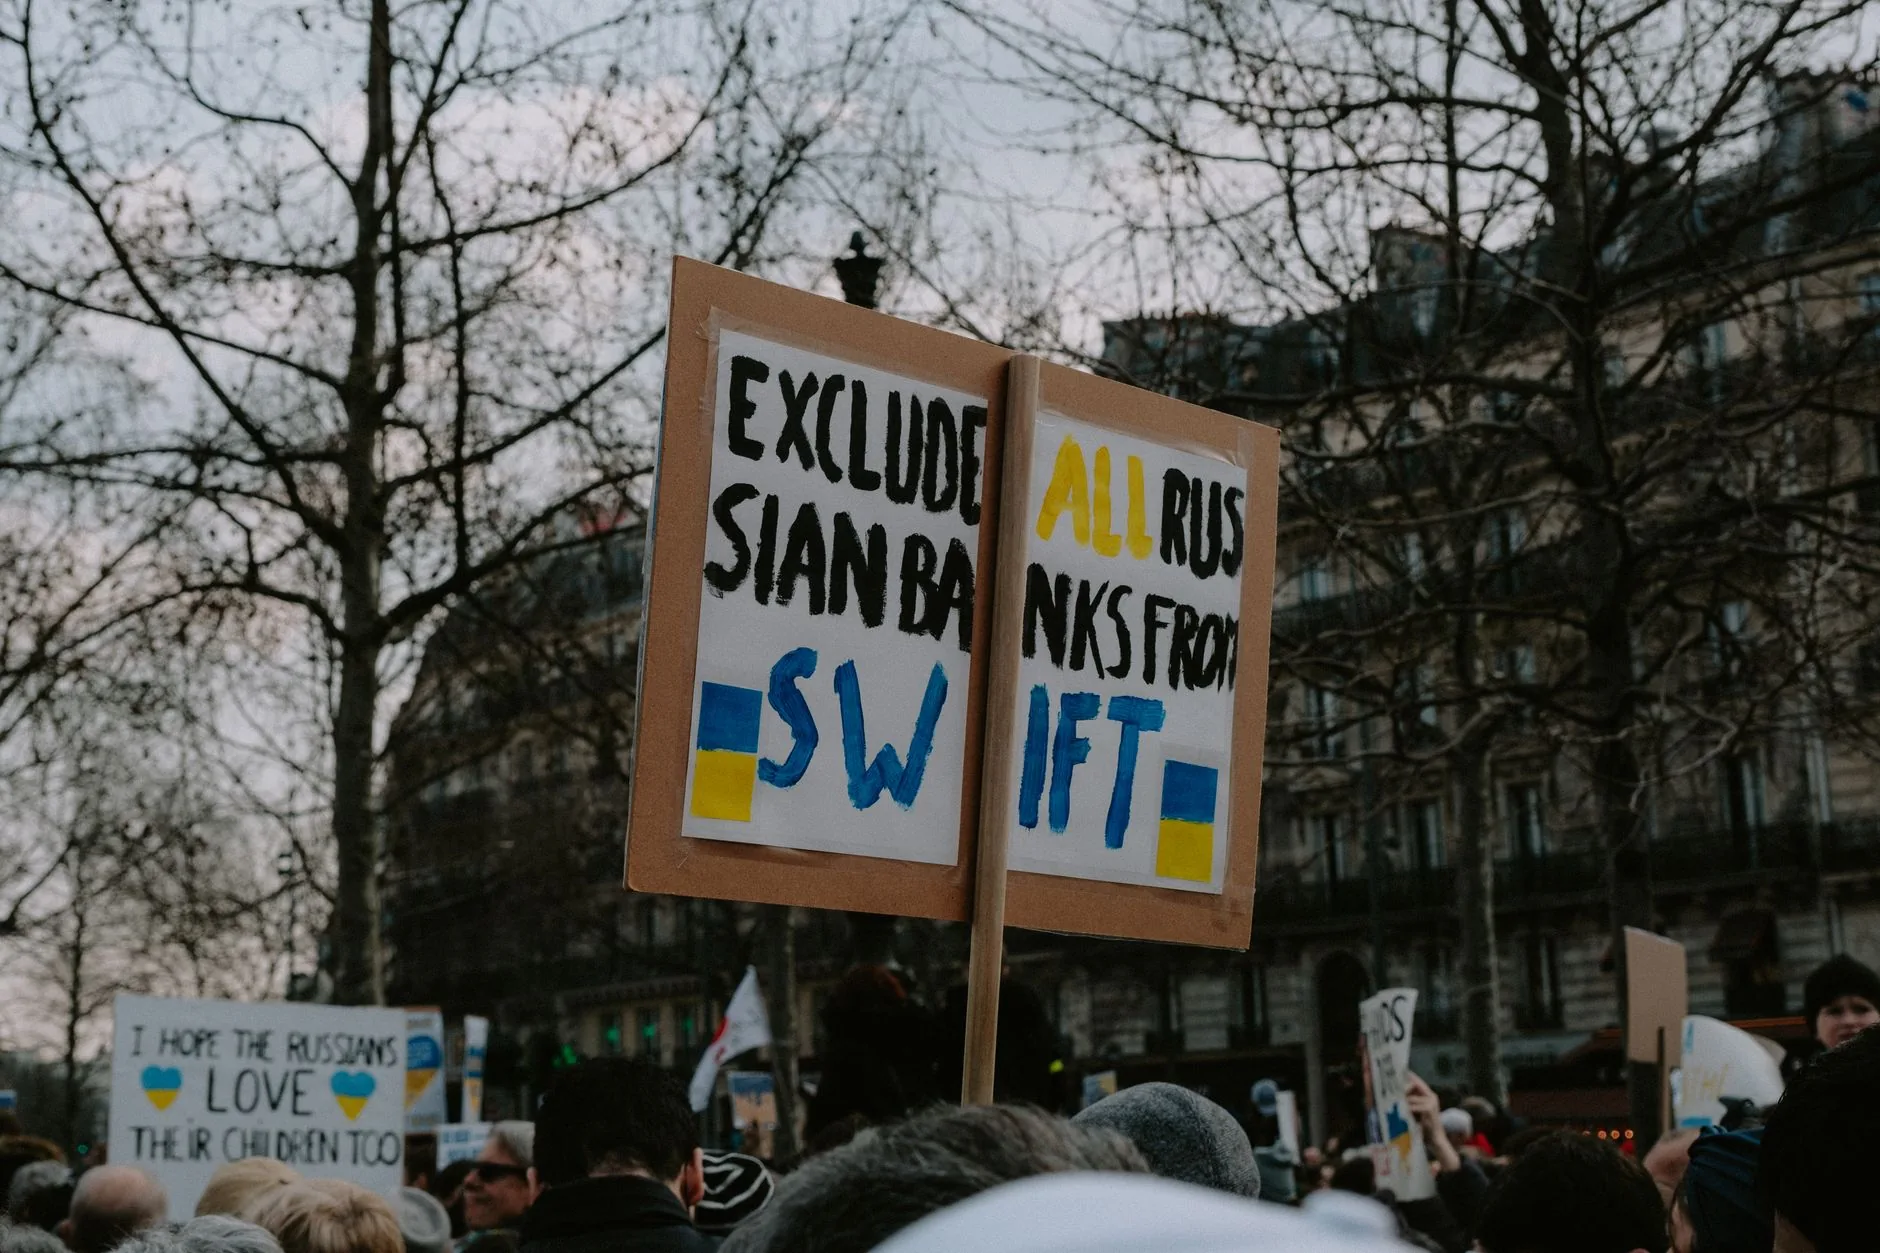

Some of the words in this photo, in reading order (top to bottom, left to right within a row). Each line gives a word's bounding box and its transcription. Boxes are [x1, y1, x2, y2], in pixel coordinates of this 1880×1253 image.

[728, 355, 987, 526] EXCLUDE
[1036, 434, 1153, 560] ALL
[1160, 467, 1245, 580] RUS
[702, 483, 887, 629] SIAN
[131, 1025, 145, 1058] I
[159, 1027, 220, 1061] HOPE
[234, 1028, 273, 1062] THE
[286, 1031, 398, 1068] RUSSIANS
[207, 1067, 316, 1117] LOVE
[346, 1130, 402, 1167] TOO
